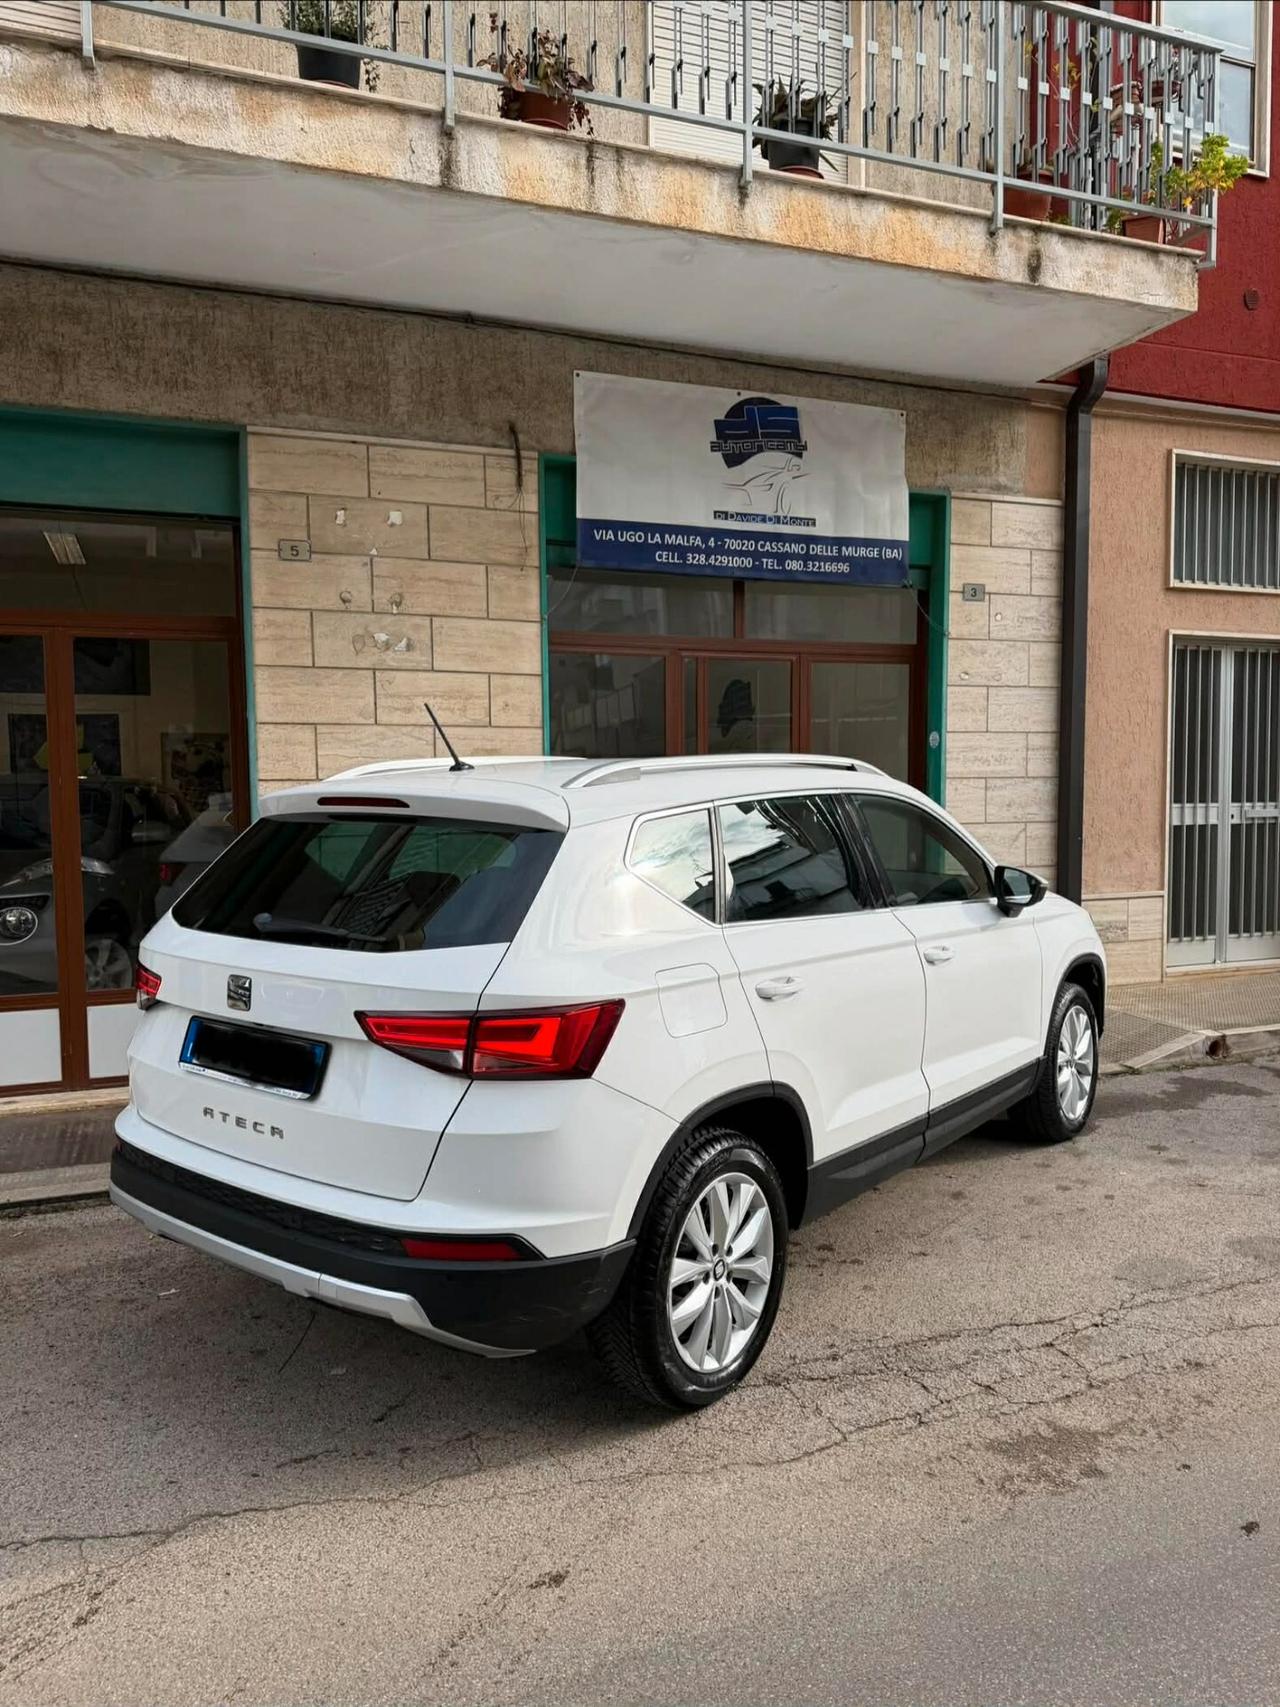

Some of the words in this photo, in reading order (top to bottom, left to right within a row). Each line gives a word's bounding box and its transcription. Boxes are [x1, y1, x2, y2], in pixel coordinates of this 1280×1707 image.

[290, 545, 299, 557] 5
[594, 529, 615, 541] VIA
[618, 531, 645, 543] UGO
[648, 532, 662, 544] LA
[664, 534, 706, 549] MALFA,
[708, 537, 715, 548] 4
[724, 538, 755, 551] 70020
[757, 541, 807, 555] CASSANO
[809, 544, 839, 556] DELLE
[841, 545, 880, 558] MURGE
[882, 546, 903, 560] (BA)
[655, 551, 683, 563] CELL.
[686, 553, 753, 568] 328.4291000
[761, 558, 782, 570] TEL.
[785, 559, 850, 573] 080.3216696
[970, 587, 977, 598] 3
[203, 1106, 285, 1140] ATECA
